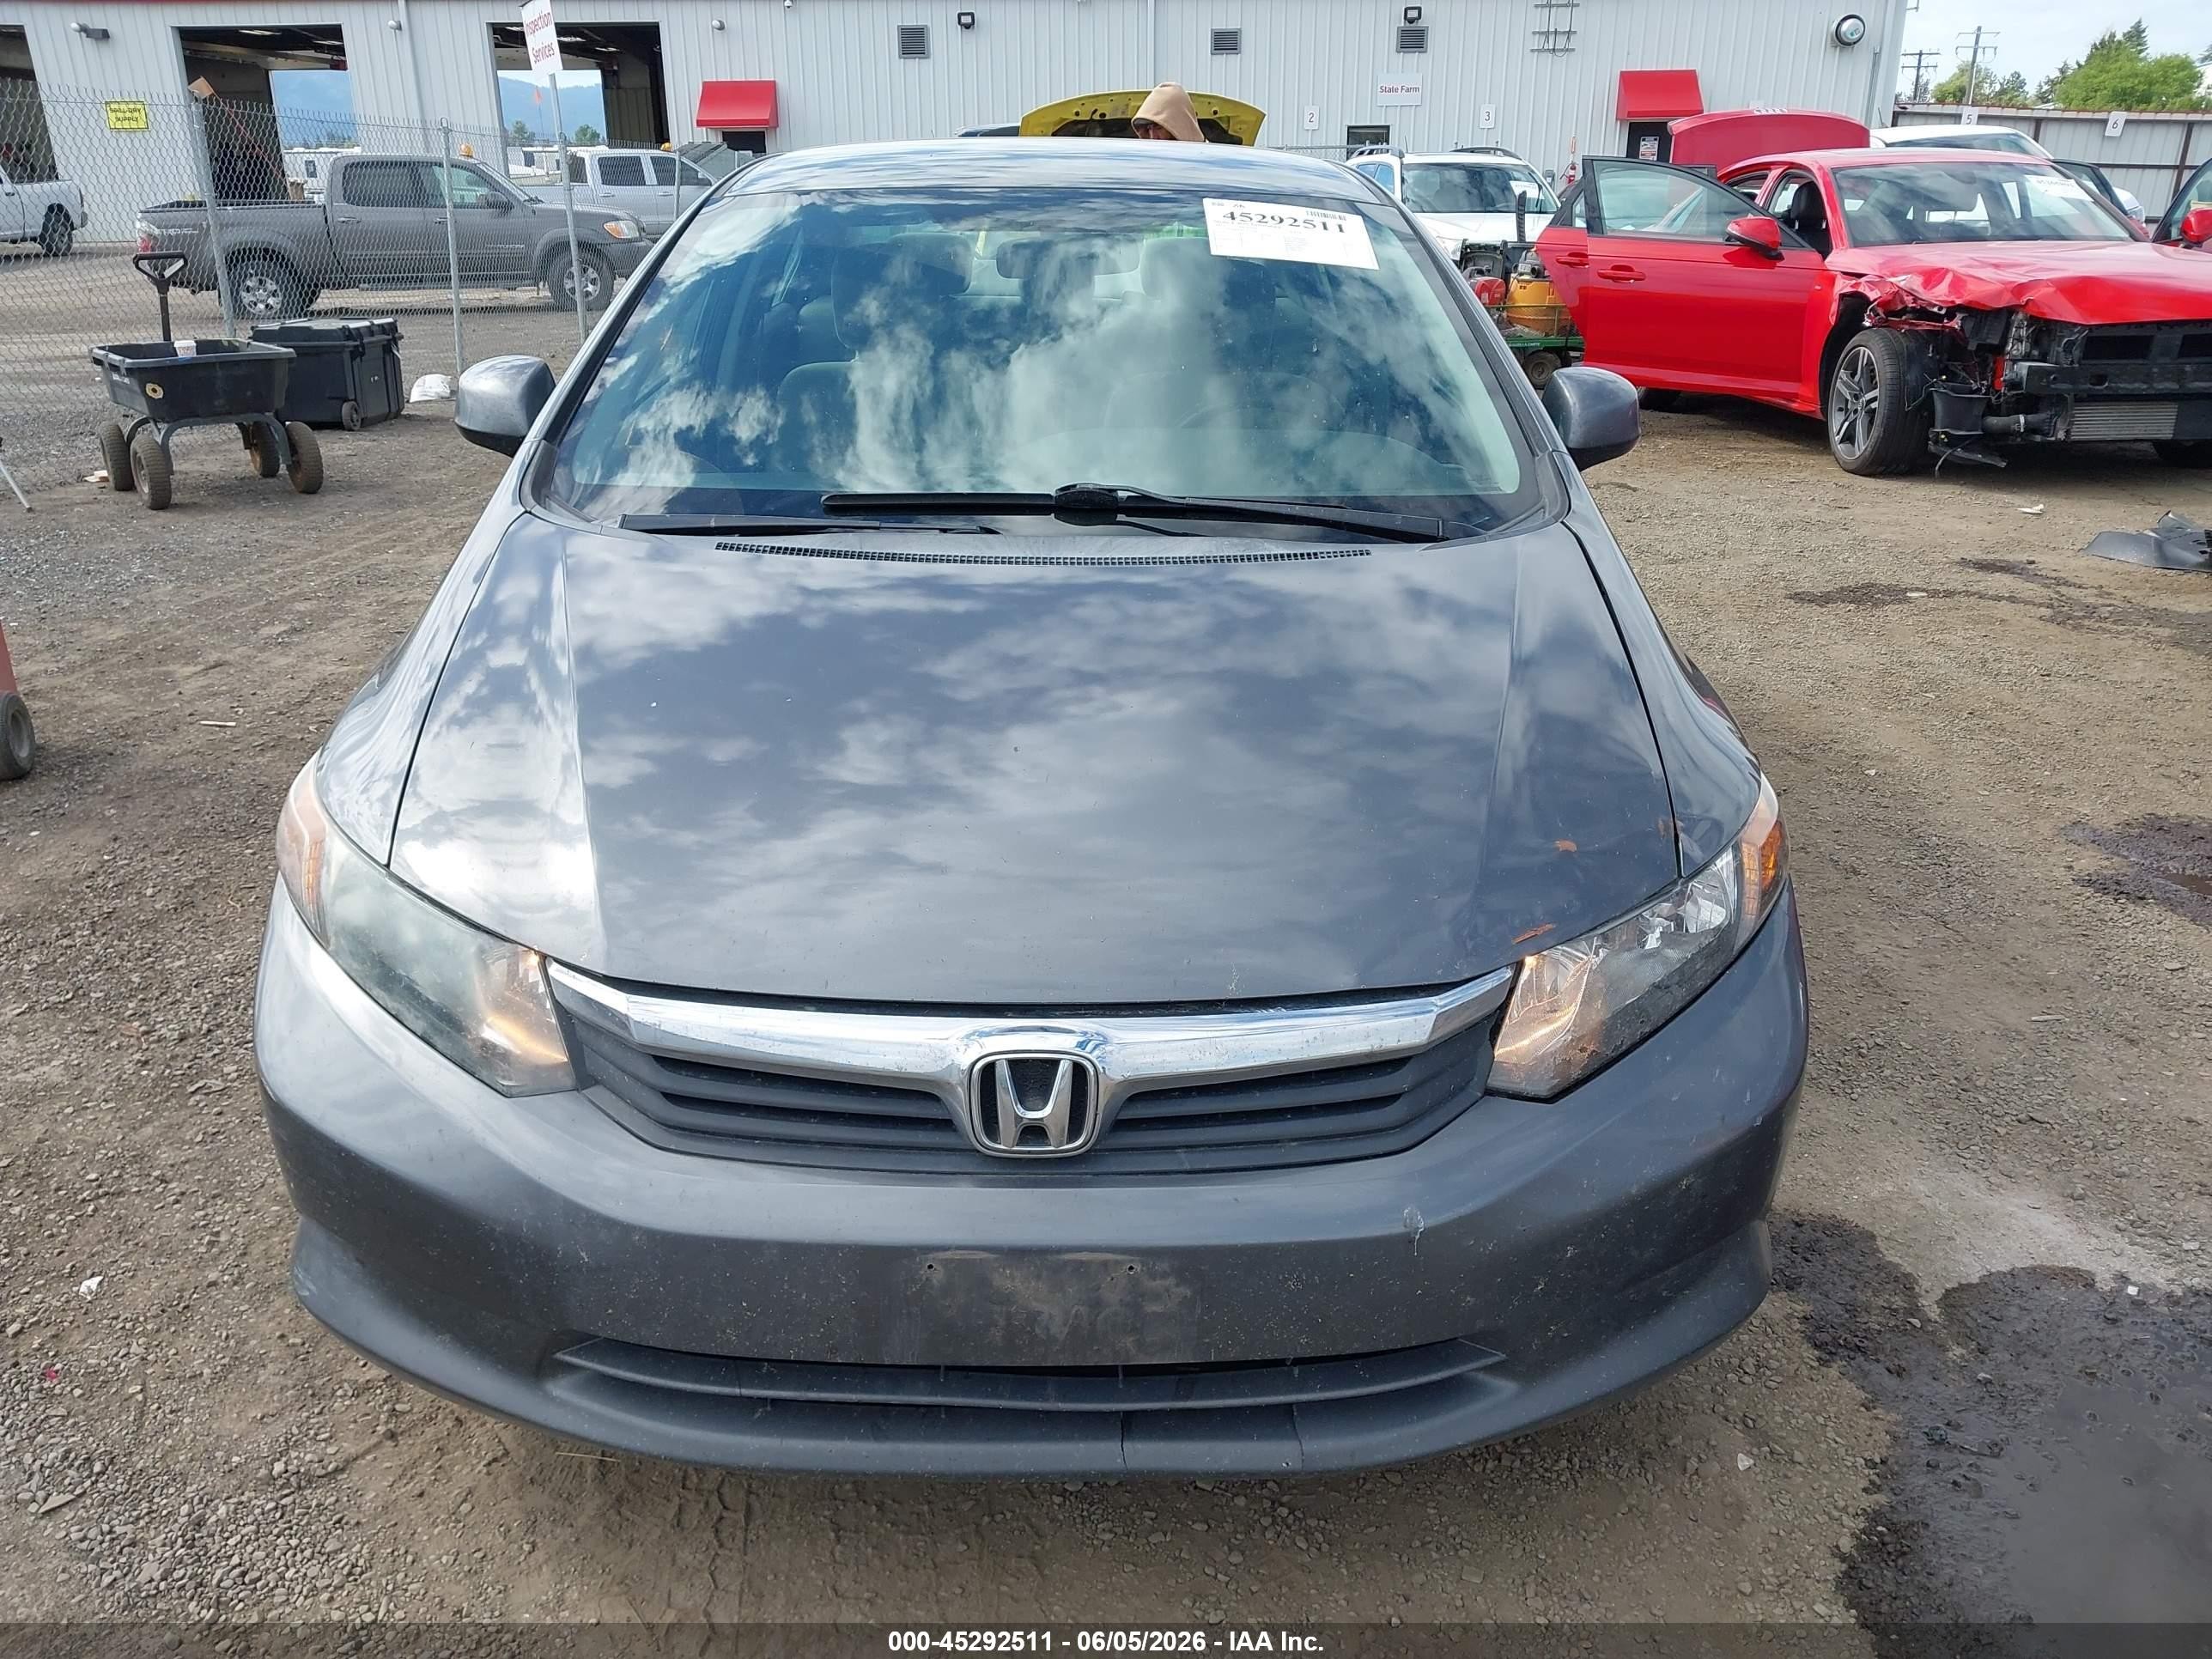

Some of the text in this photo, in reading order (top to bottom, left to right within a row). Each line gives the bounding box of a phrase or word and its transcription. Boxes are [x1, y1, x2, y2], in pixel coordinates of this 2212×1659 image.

[525, 9, 553, 37] Inspection
[532, 41, 555, 64] Services
[1379, 85, 1420, 94] State Farm
[1308, 112, 1315, 123] 2
[1484, 111, 1491, 122] 3
[1966, 113, 1973, 125] 5
[2112, 118, 2119, 130] 6
[1222, 210, 1346, 234] 45292511
